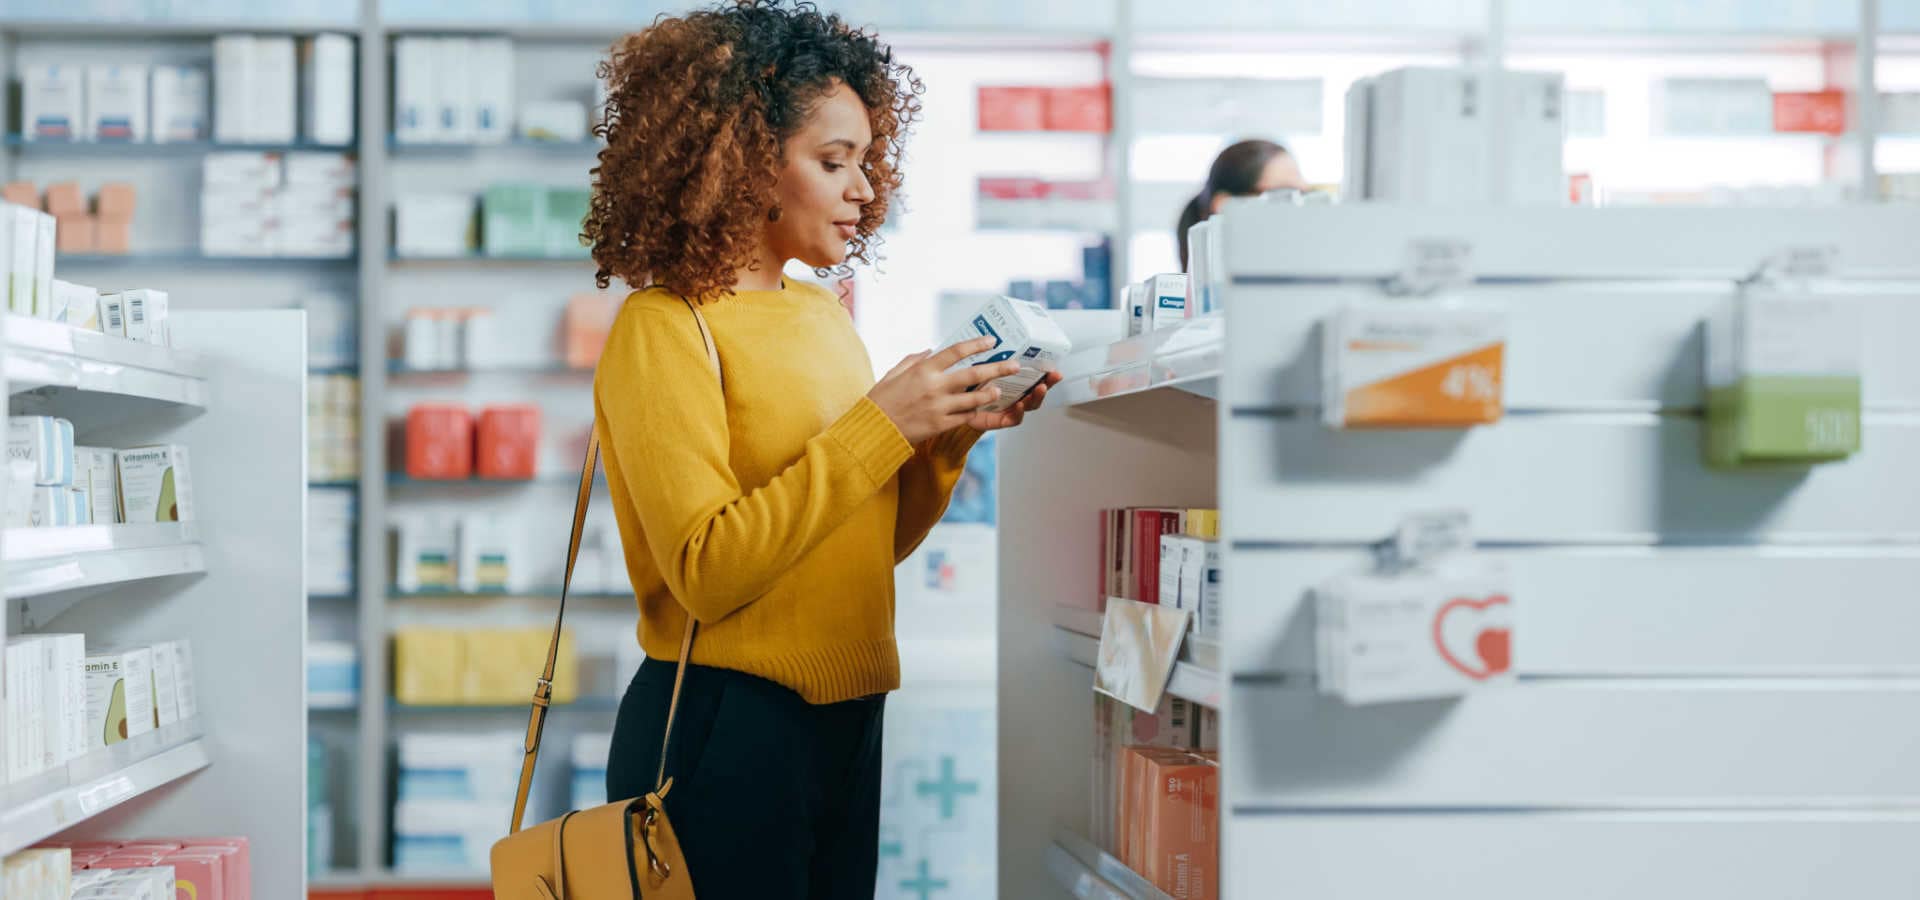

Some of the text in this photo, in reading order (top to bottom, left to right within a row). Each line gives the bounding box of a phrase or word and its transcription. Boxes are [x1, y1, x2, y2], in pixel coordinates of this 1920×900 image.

[123, 451, 167, 463] vitamin E
[112, 661, 118, 670] E
